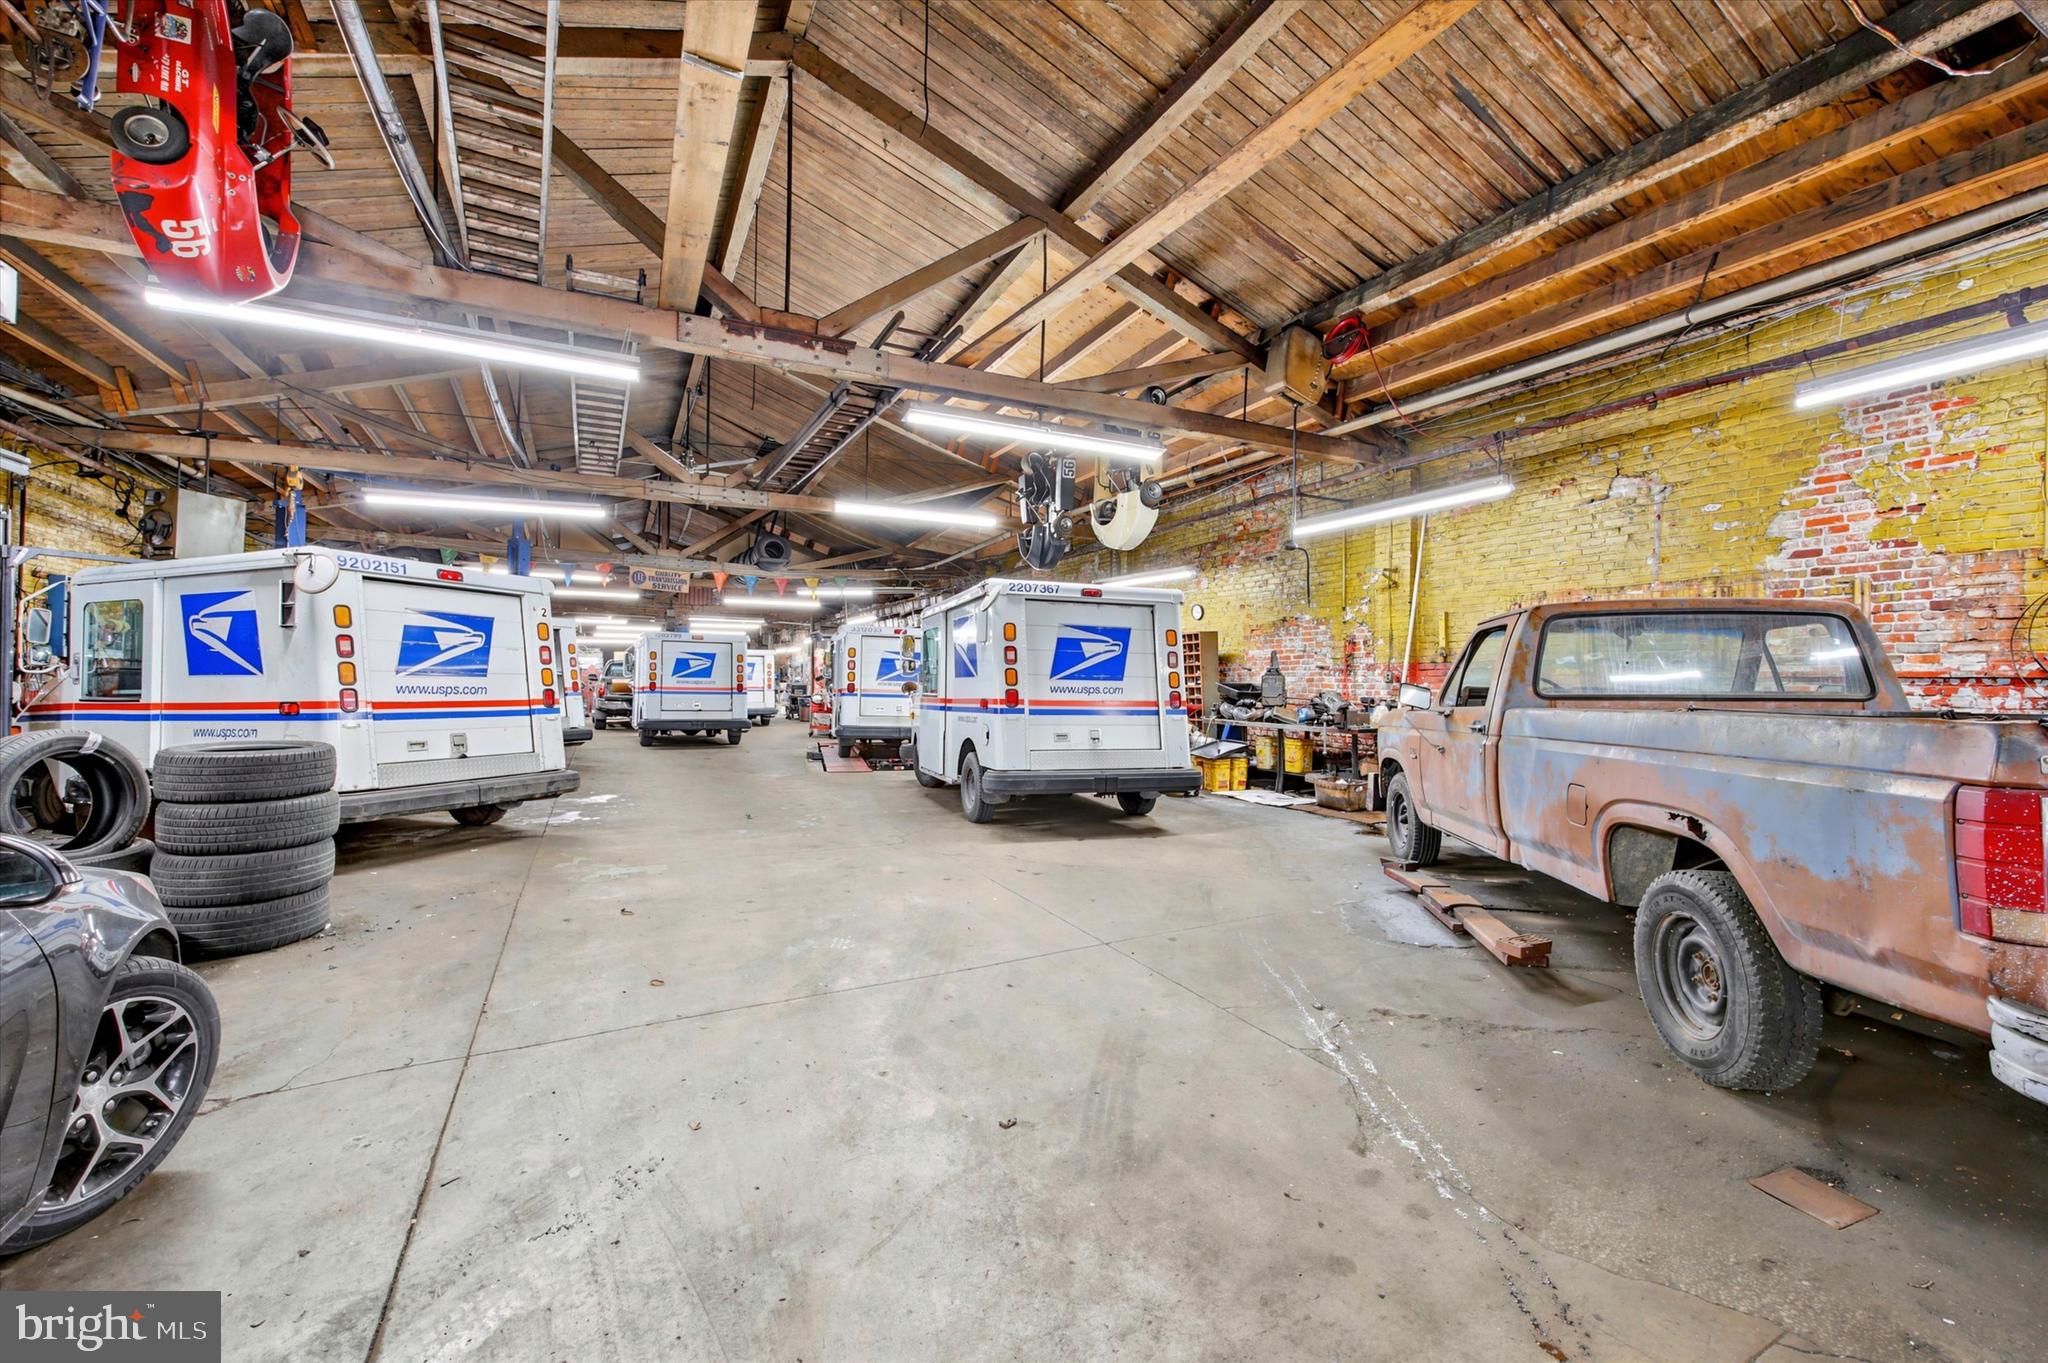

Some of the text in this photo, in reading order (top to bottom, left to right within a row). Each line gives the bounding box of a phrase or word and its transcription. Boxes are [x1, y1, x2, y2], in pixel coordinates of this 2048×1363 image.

[161, 218, 211, 258] 56
[1063, 461, 1075, 477] 56
[336, 555, 407, 575] 9202151
[648, 576, 688, 585] TRANSMISSION
[652, 583, 682, 591] SERVICE
[1008, 582, 1060, 594] 2207367
[395, 685, 488, 697] www.usps.com
[1050, 685, 1124, 696] www.usps.com
[193, 727, 258, 738] www.usps.com
